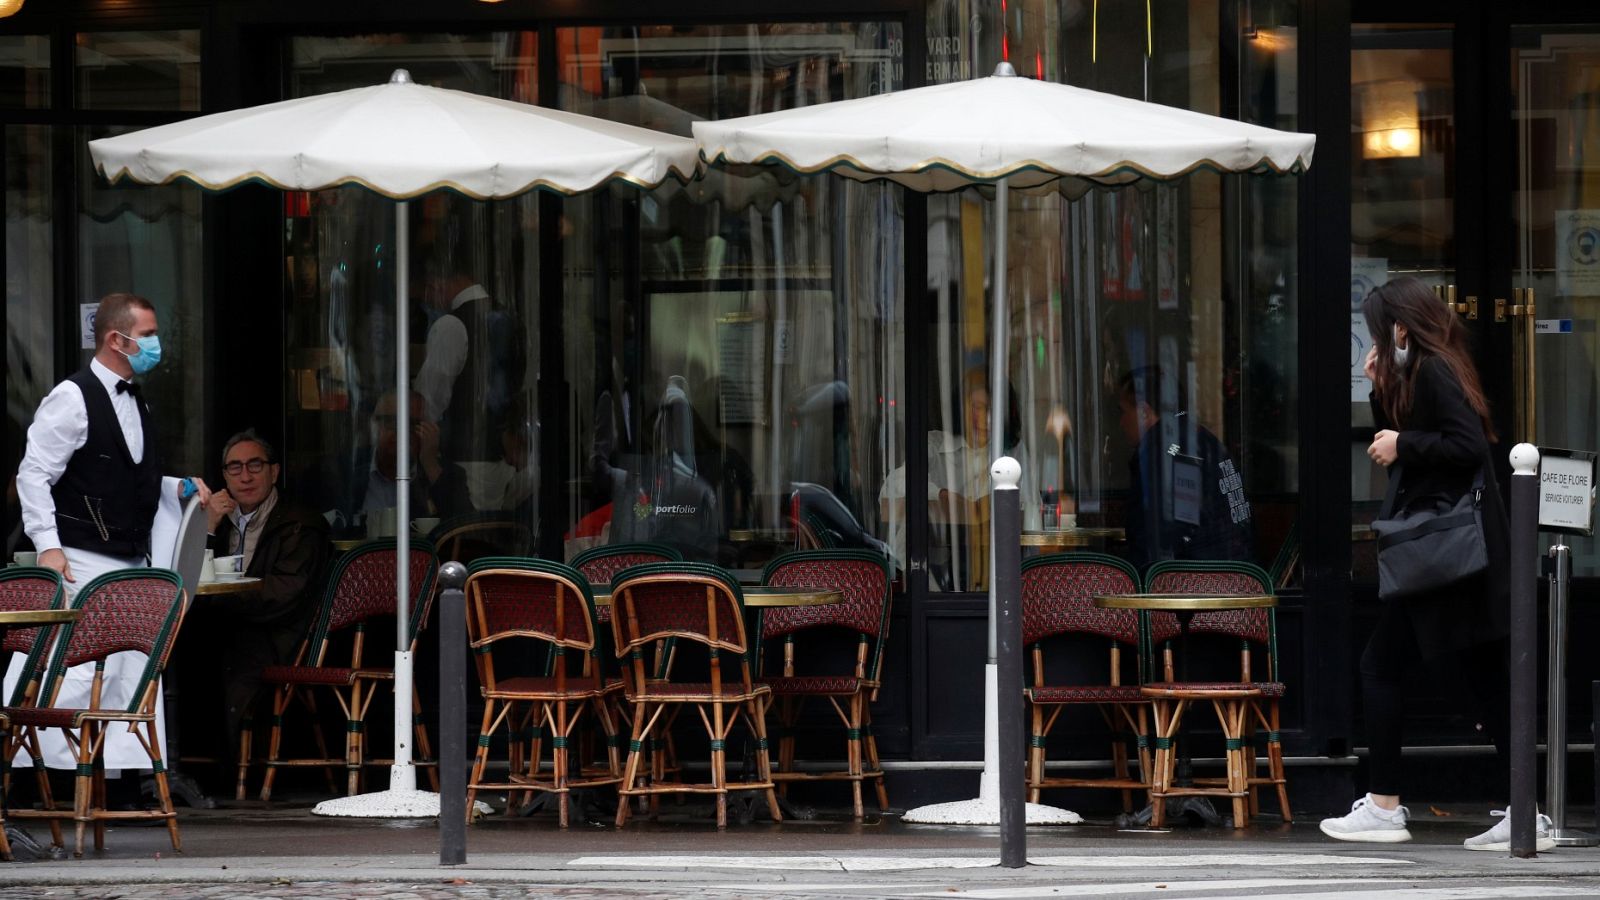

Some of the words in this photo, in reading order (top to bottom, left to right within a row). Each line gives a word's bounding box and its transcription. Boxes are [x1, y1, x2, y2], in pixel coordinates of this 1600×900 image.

[1542, 472, 1558, 484] CAFE
[1559, 474, 1567, 484] DE
[1569, 475, 1588, 486] FLORE
[1545, 493, 1562, 504] SERVICE
[655, 504, 696, 516] portfolio
